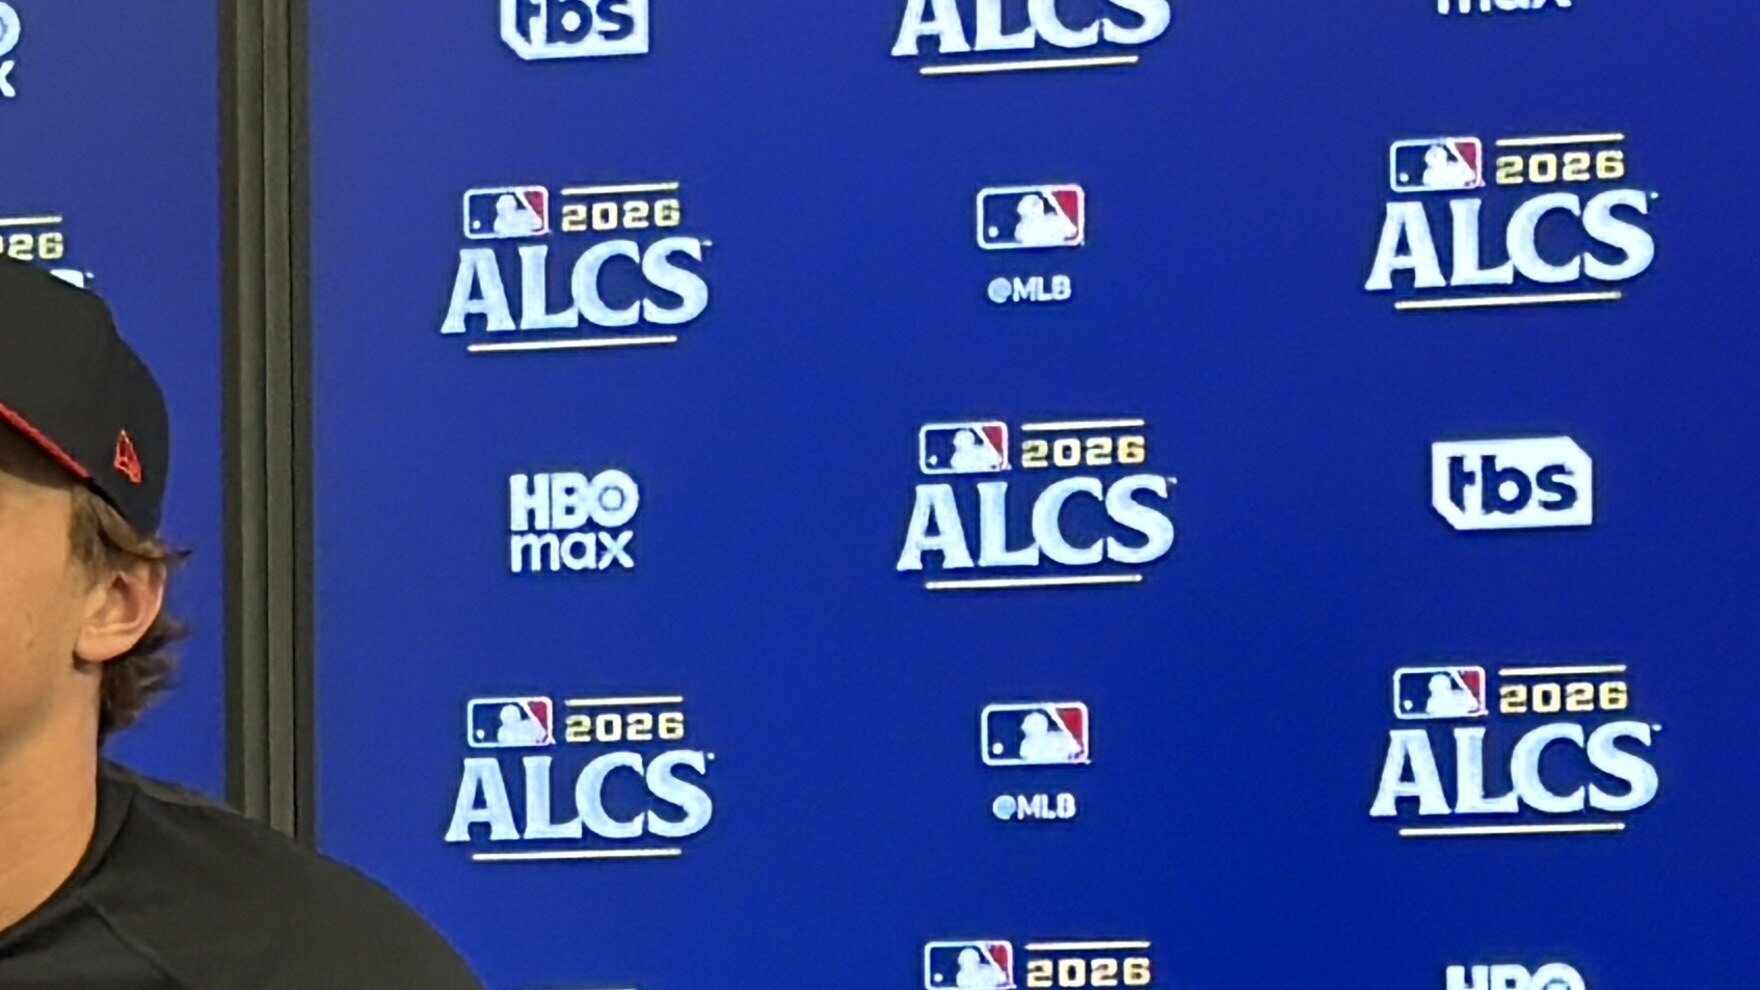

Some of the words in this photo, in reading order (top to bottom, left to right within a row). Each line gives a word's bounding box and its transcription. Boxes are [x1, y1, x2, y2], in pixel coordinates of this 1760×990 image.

[1496, 152, 1625, 184] 2026
[562, 201, 680, 231] 2026
[1365, 189, 1655, 291] ALCS
[441, 238, 709, 333] ALCS
[987, 277, 1072, 303] @MLB
[1021, 437, 1146, 468] 2026
[510, 470, 639, 531] HBO
[1447, 456, 1577, 516] tbs
[896, 474, 1175, 571] ALCS
[510, 531, 634, 572] max
[1500, 682, 1628, 714] 2026
[565, 714, 685, 742] 2026
[1369, 721, 1659, 817] ALCS
[445, 751, 713, 842] ALCS
[992, 795, 1076, 820] @MLB
[1027, 959, 1150, 988] 2026
